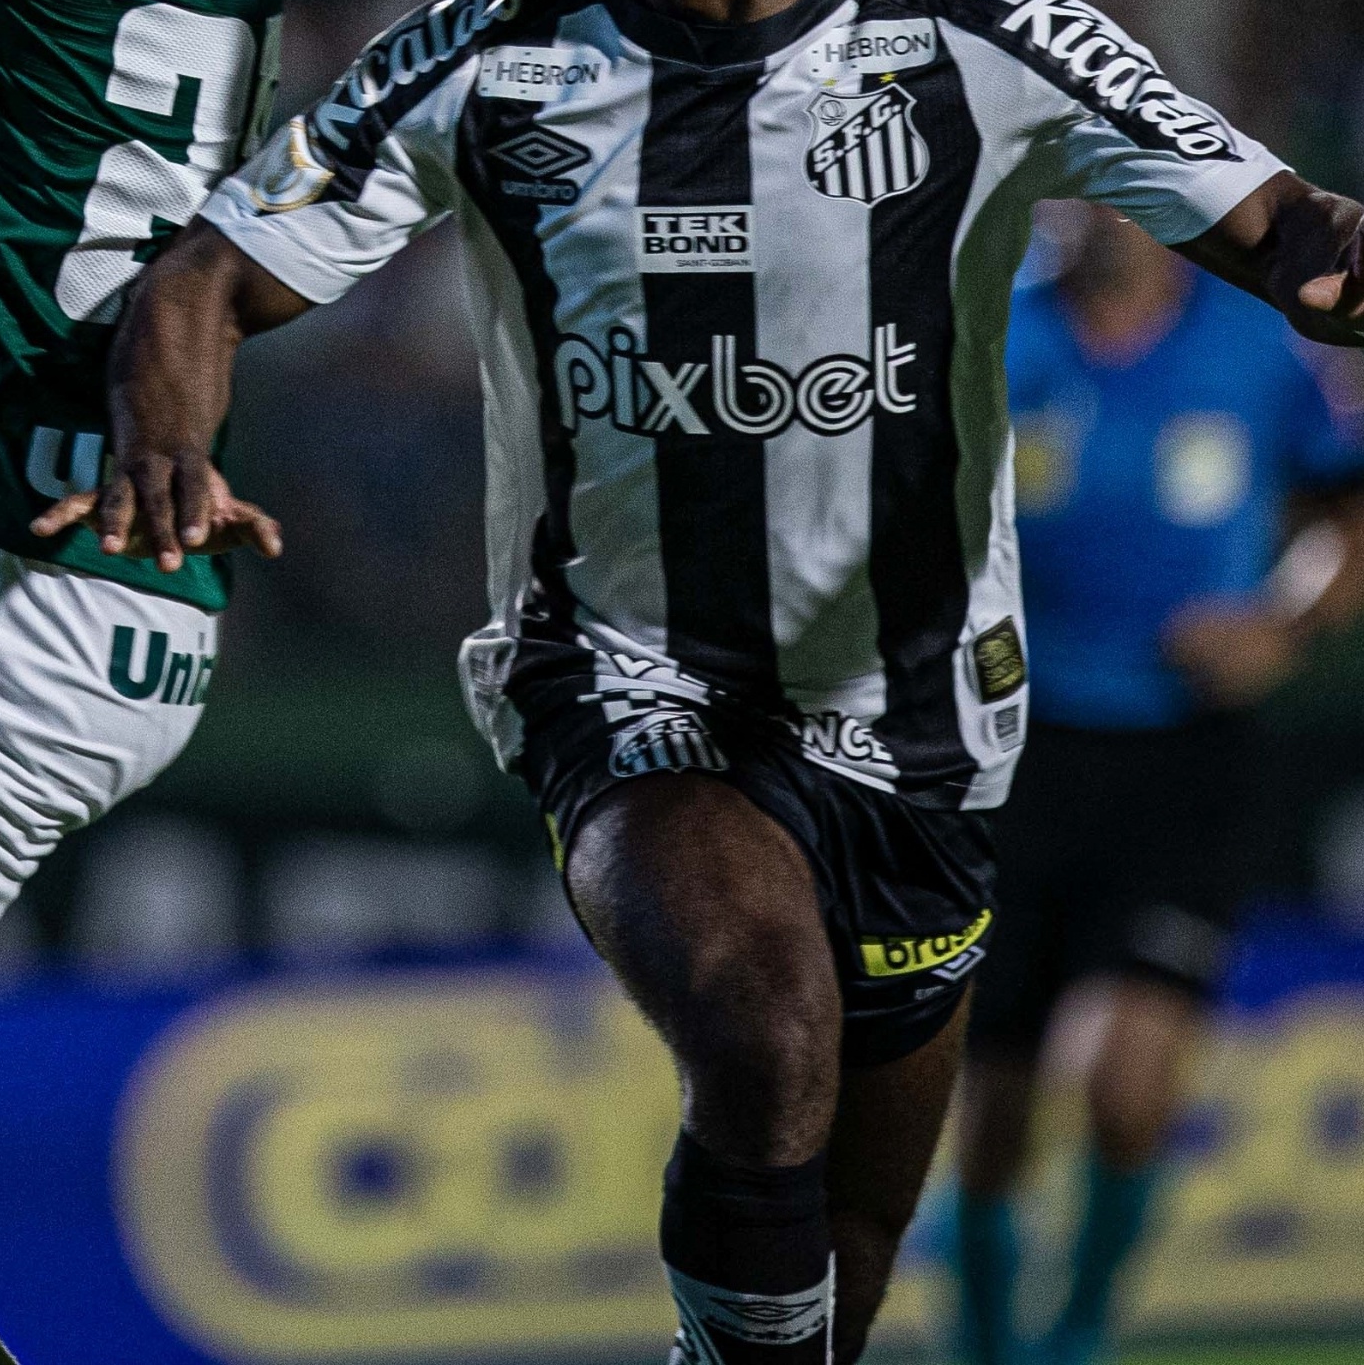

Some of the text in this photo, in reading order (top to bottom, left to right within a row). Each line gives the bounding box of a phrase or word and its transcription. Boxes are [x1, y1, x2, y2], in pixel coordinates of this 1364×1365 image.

[825, 33, 930, 63] HEBRON
[496, 61, 600, 86] HEBRON
[646, 216, 745, 234] TEK
[644, 236, 748, 254] BOND
[554, 323, 917, 435] pixbet
